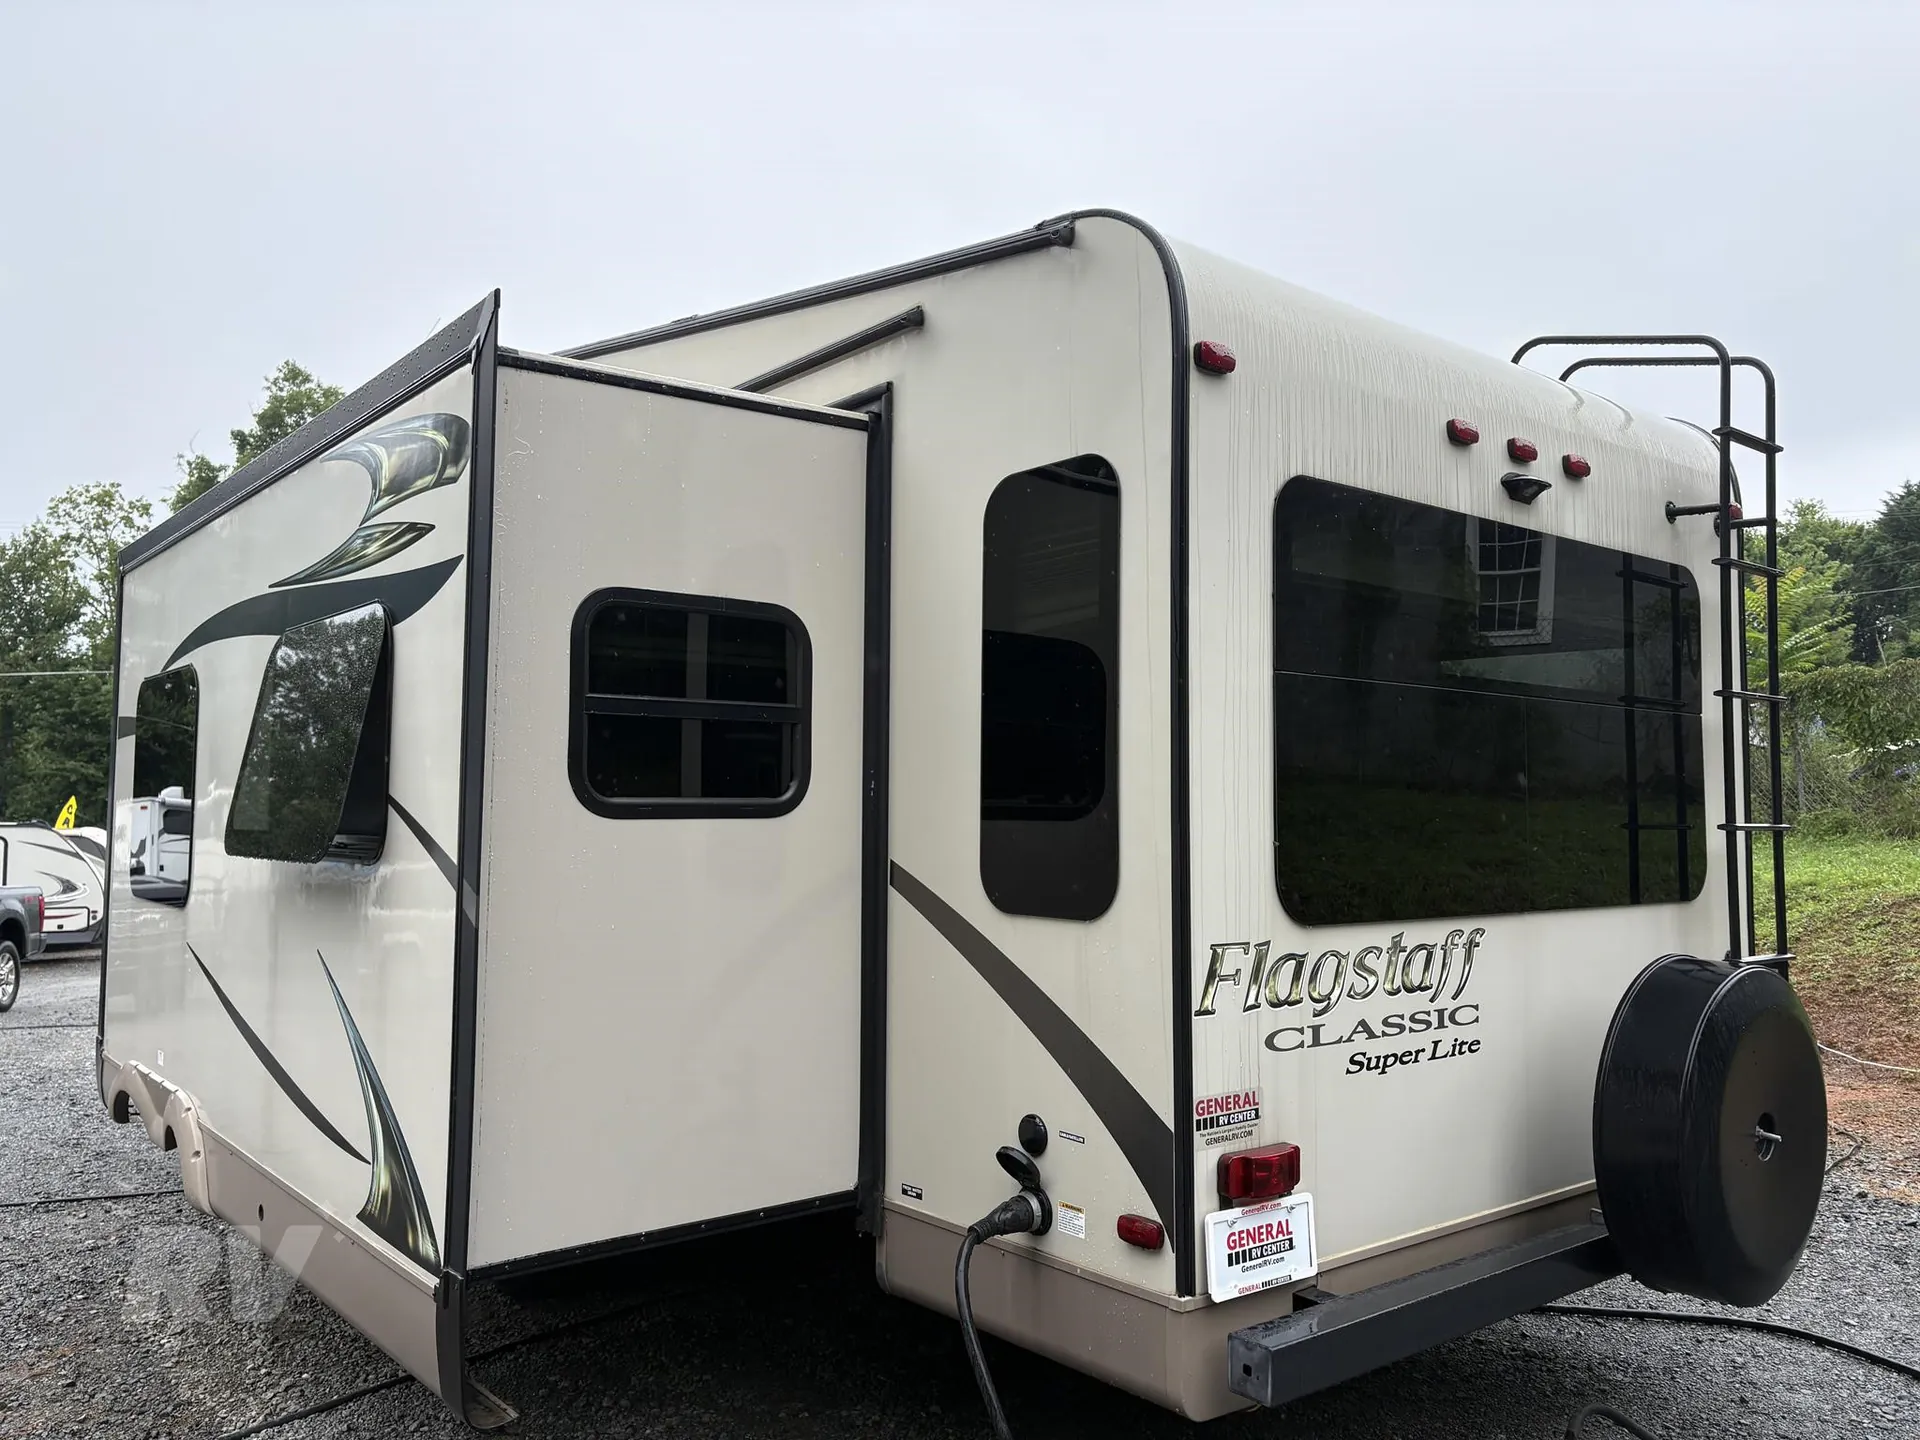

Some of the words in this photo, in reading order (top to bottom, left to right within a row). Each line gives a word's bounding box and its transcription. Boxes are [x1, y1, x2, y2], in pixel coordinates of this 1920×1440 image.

[1193, 928, 1486, 1018] Flagstaff
[1264, 1004, 1480, 1052] CLASSIC
[1345, 1049, 1425, 1076] Super
[1427, 1038, 1481, 1062] Lite
[1195, 1091, 1259, 1117] GENERAL
[1219, 1114, 1229, 1126] RV
[1229, 1110, 1256, 1124] CENTER
[1205, 1129, 1254, 1146] GENERALRV.COM
[1241, 1202, 1282, 1216] GeneralRV.com
[1226, 1218, 1293, 1251] GENERAL
[1251, 1247, 1262, 1259] RV
[1262, 1240, 1290, 1256] CENTER
[1241, 1256, 1285, 1273] GeneralRV.com
[1237, 1283, 1262, 1295] GENERAL
